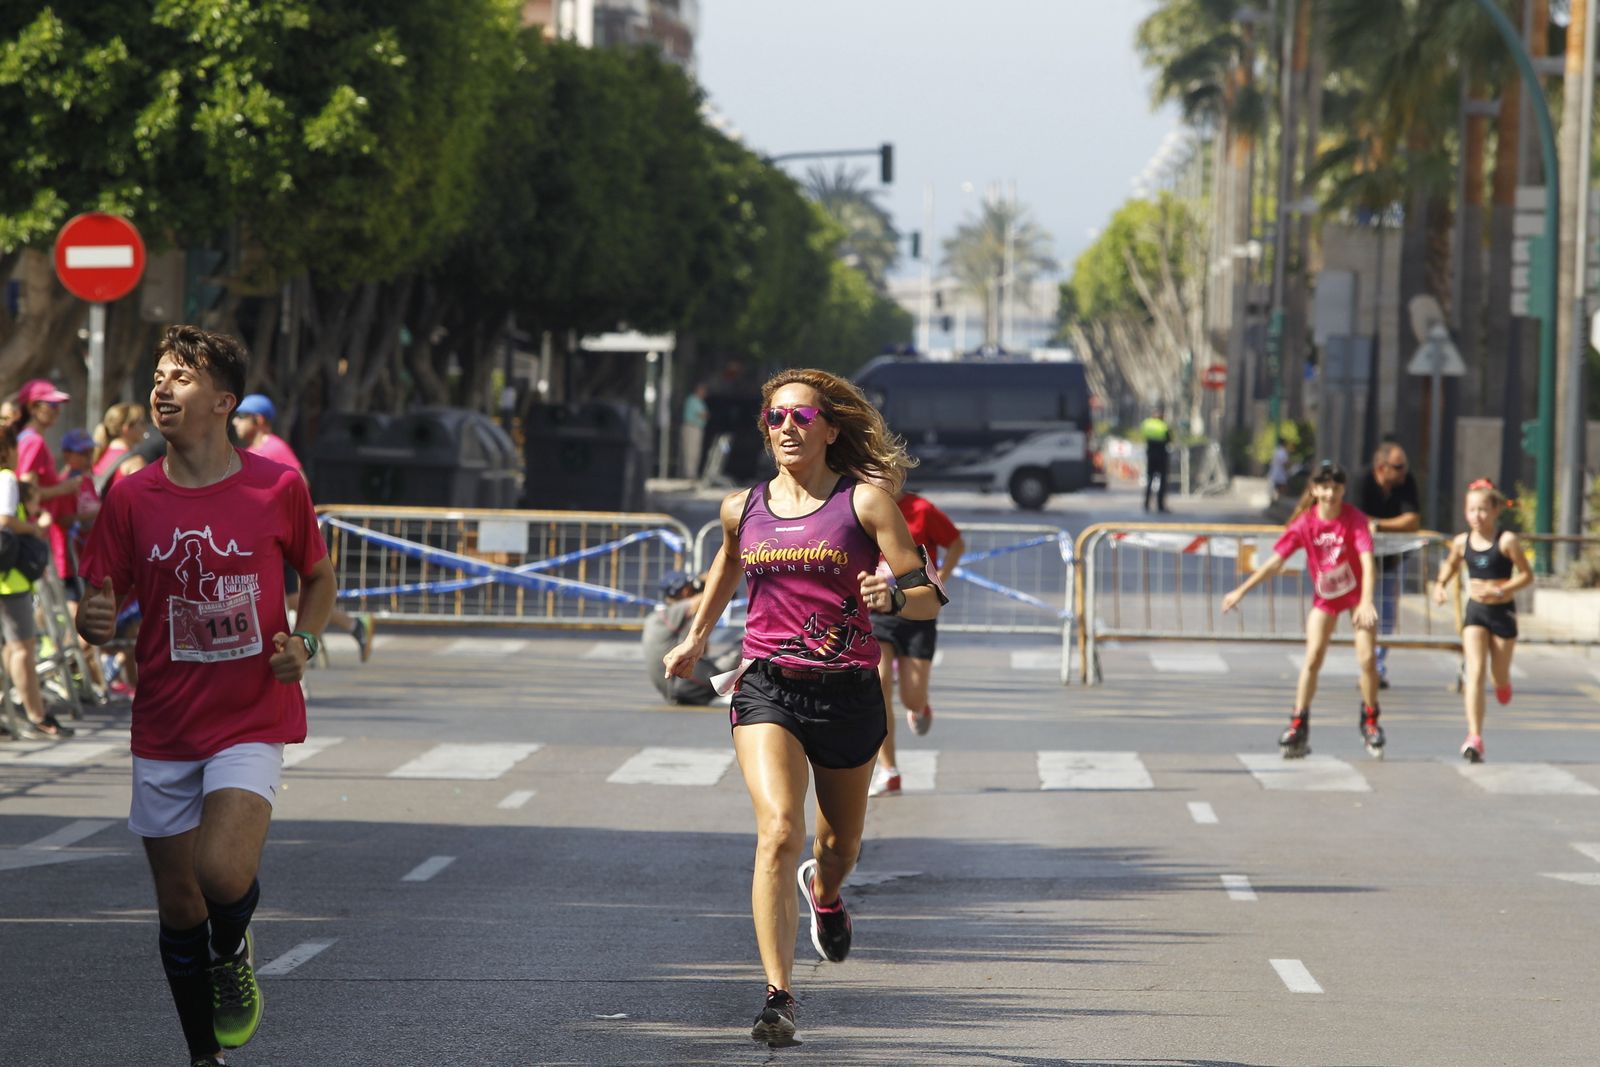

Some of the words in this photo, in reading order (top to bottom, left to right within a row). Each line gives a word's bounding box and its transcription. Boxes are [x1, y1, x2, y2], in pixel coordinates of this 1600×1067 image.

[741, 538, 848, 568] Salamandras
[746, 564, 841, 578] RUNNERS
[212, 575, 225, 602] 4
[206, 612, 248, 638] 116
